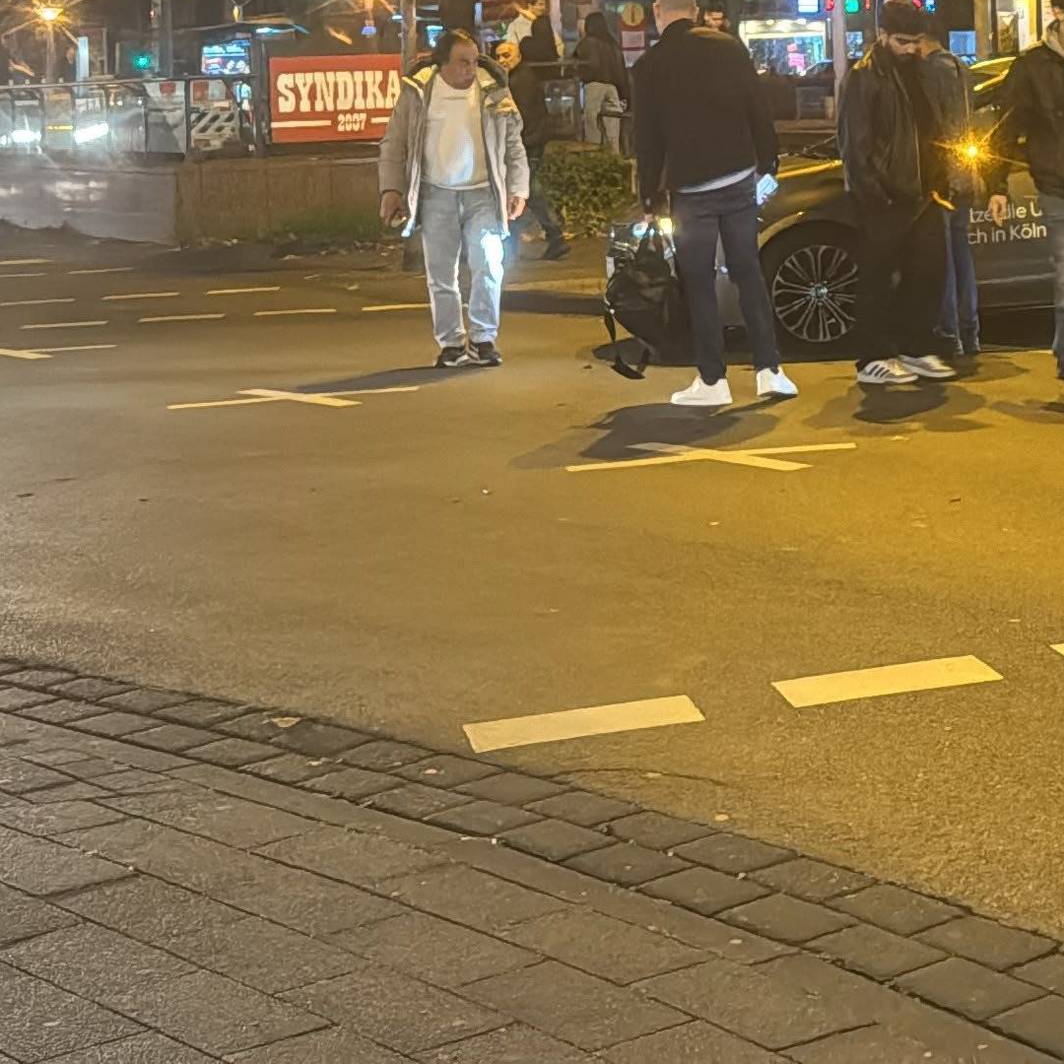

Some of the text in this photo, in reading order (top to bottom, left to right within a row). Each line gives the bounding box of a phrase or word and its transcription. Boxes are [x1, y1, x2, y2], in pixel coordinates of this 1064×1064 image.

[337, 113, 367, 132] 2007
[991, 227, 1006, 243] in
[1010, 223, 1047, 240] Köln
